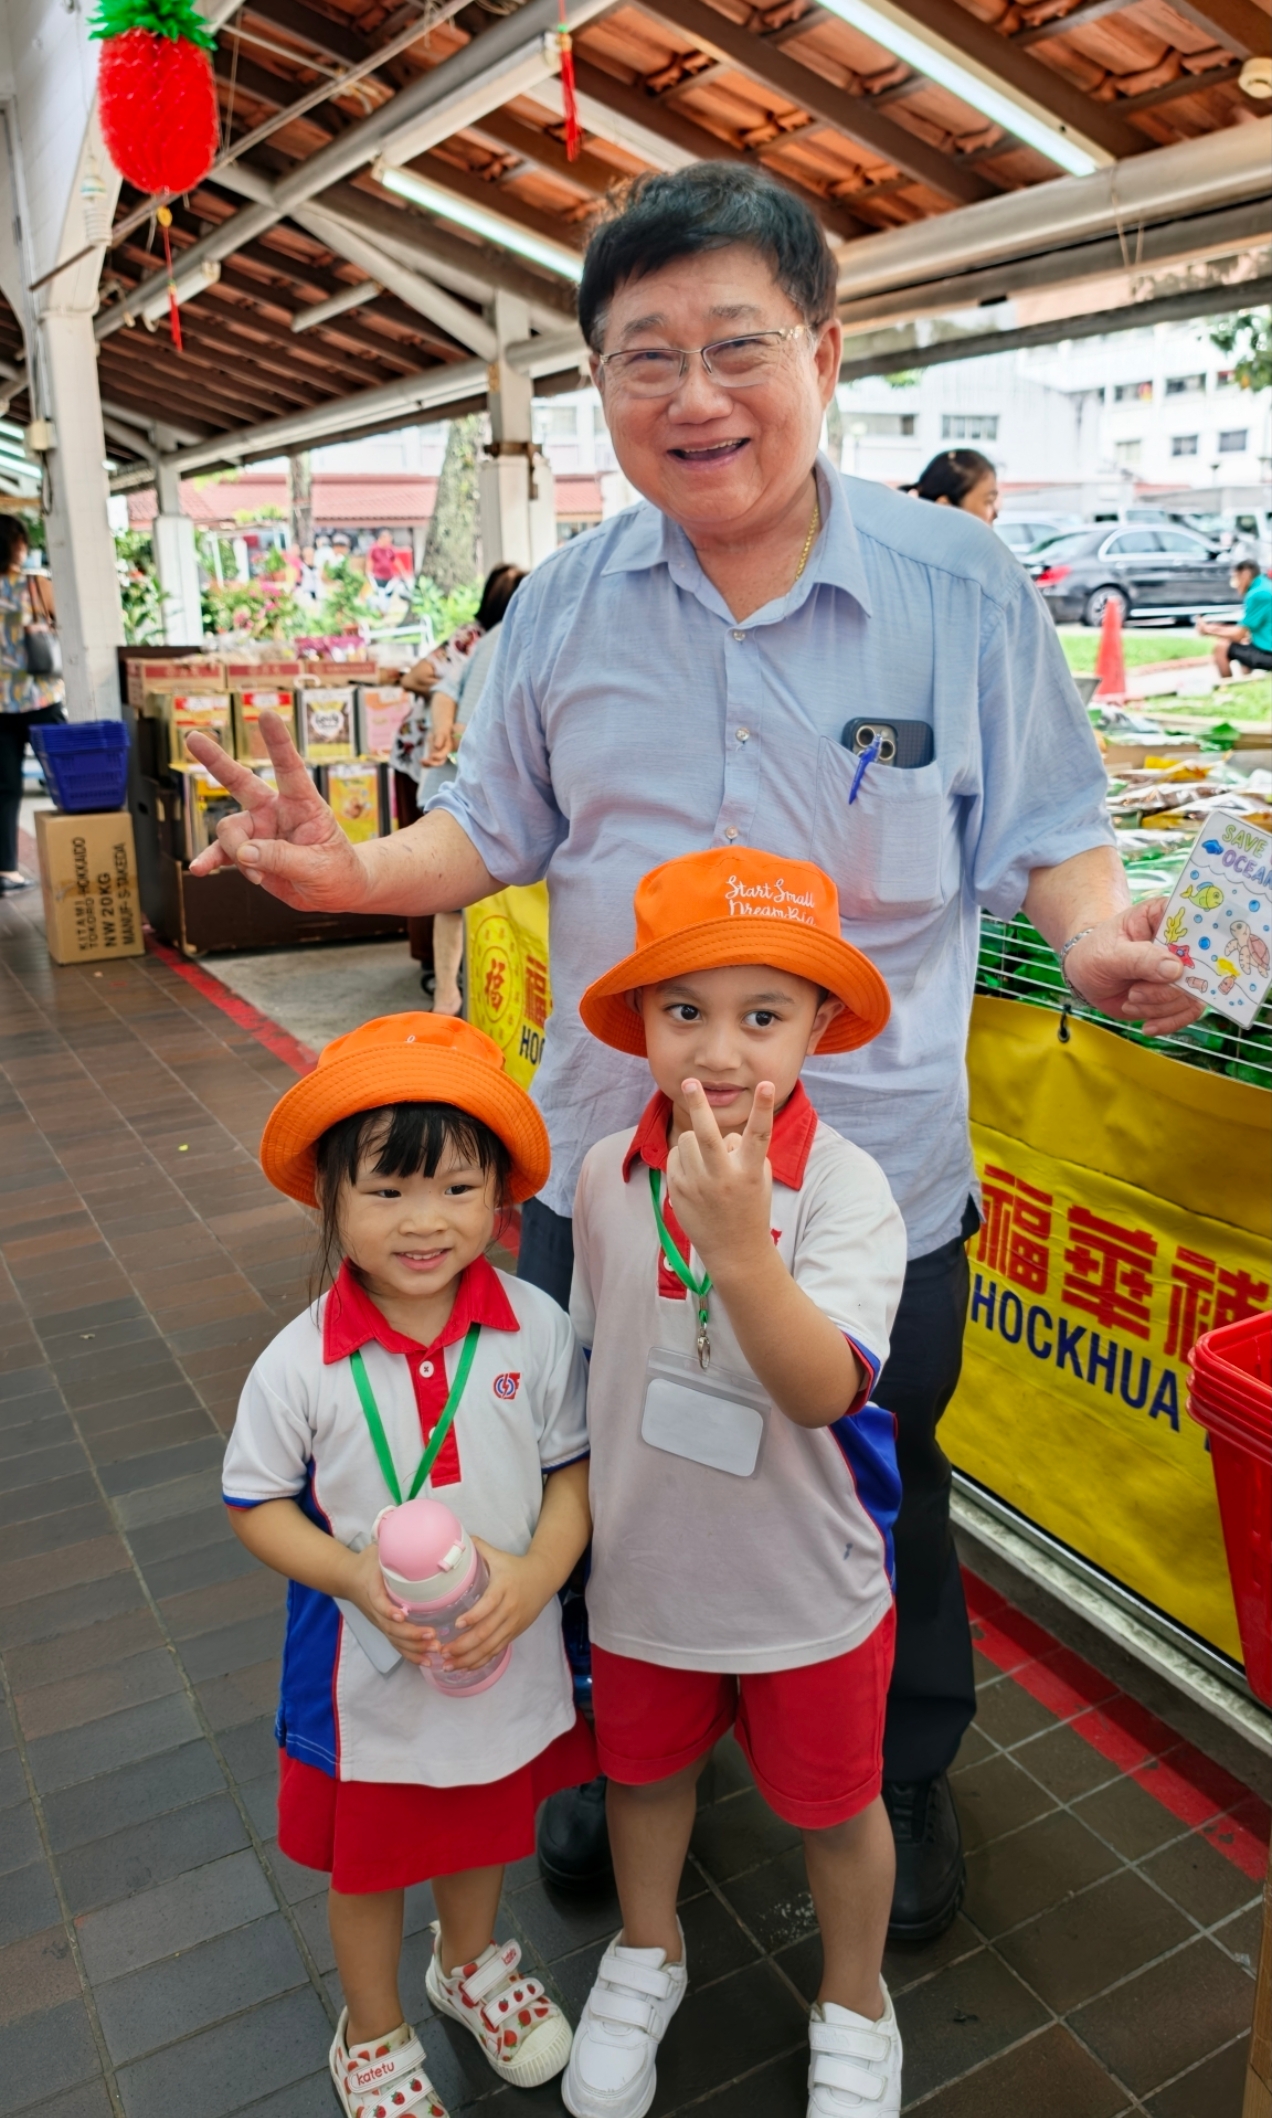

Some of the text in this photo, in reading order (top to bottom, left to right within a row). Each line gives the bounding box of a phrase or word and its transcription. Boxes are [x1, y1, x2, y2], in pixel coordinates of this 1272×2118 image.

[1222, 824, 1268, 859] SAVE
[725, 874, 815, 909] Start Small
[74, 900, 89, 951] KITAMI
[84, 897, 98, 949] TOKORO
[102, 922, 118, 948] NW
[970, 1272, 1181, 1433] HOCKHUA
[356, 2060, 395, 2086] katetu
